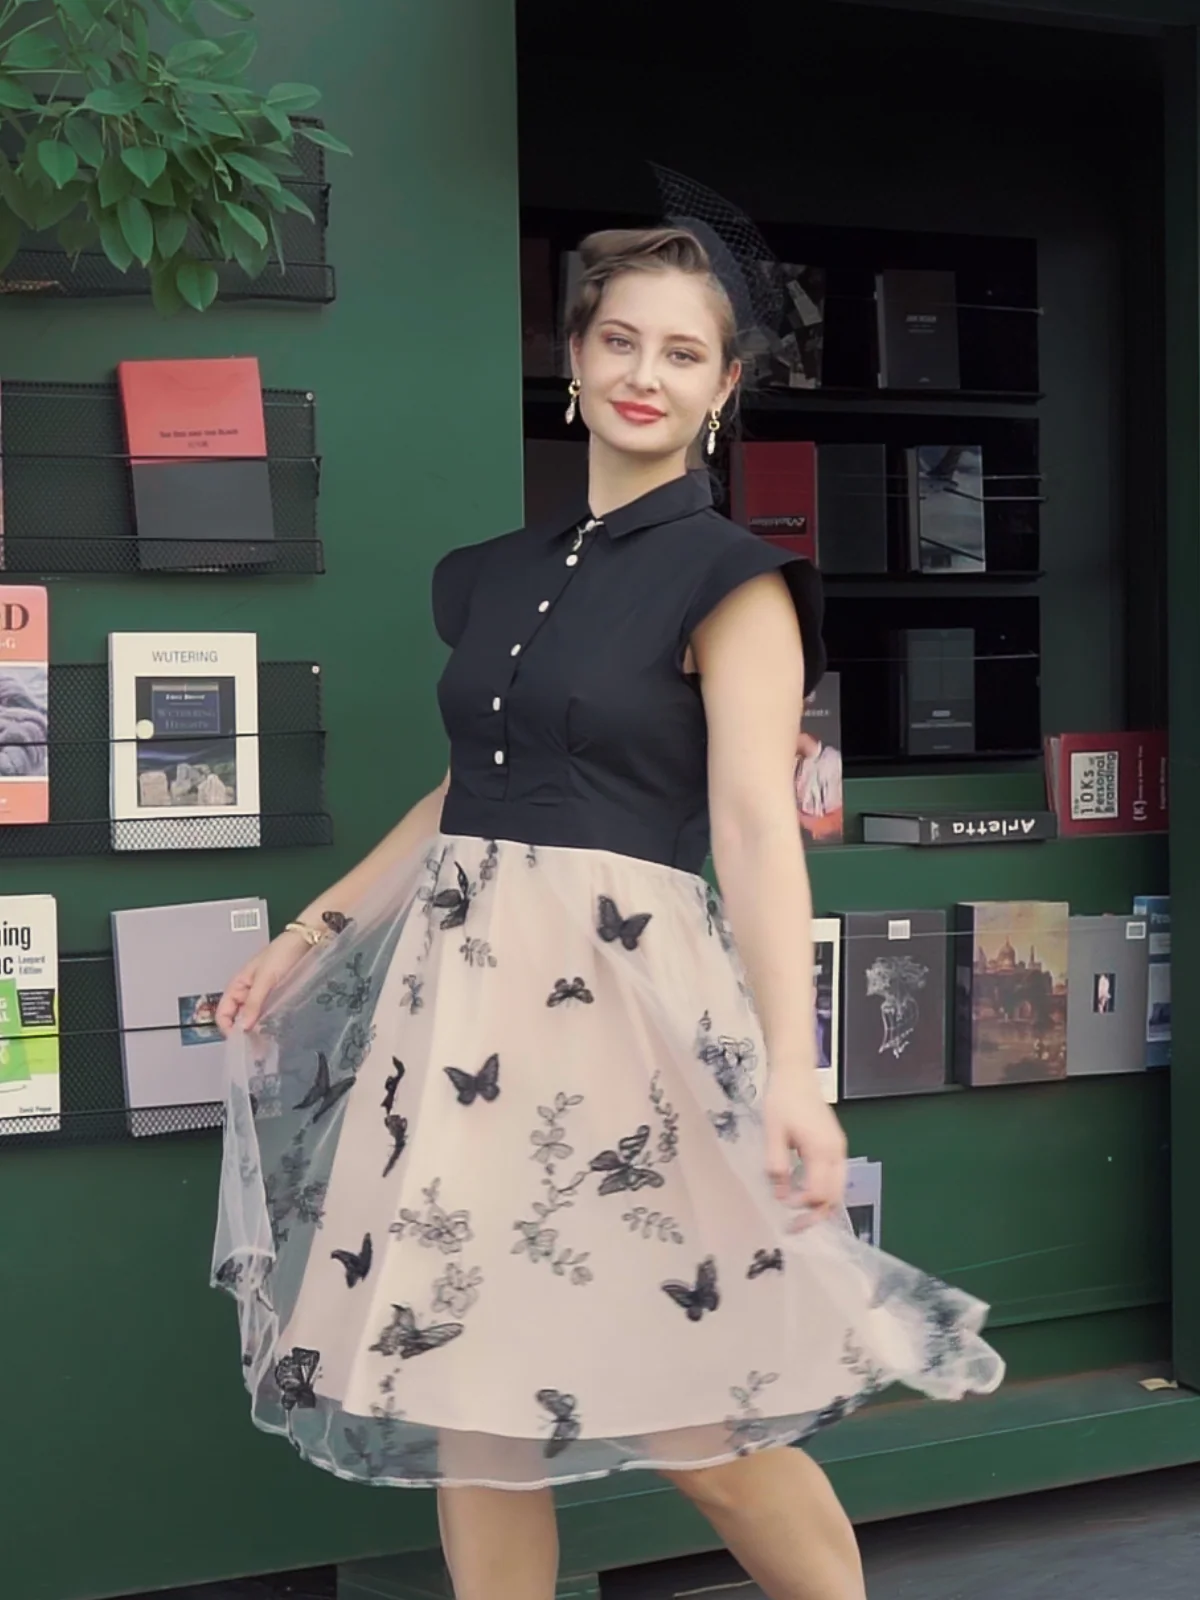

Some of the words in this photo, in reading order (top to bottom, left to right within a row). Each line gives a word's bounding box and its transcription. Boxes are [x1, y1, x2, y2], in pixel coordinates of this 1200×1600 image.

[1, 603, 30, 630] D
[152, 650, 219, 663] WUTERING
[1095, 755, 1105, 813] Personal
[1104, 752, 1117, 813] Branding
[952, 819, 1036, 836] Arletta
[0, 920, 31, 951] ing
